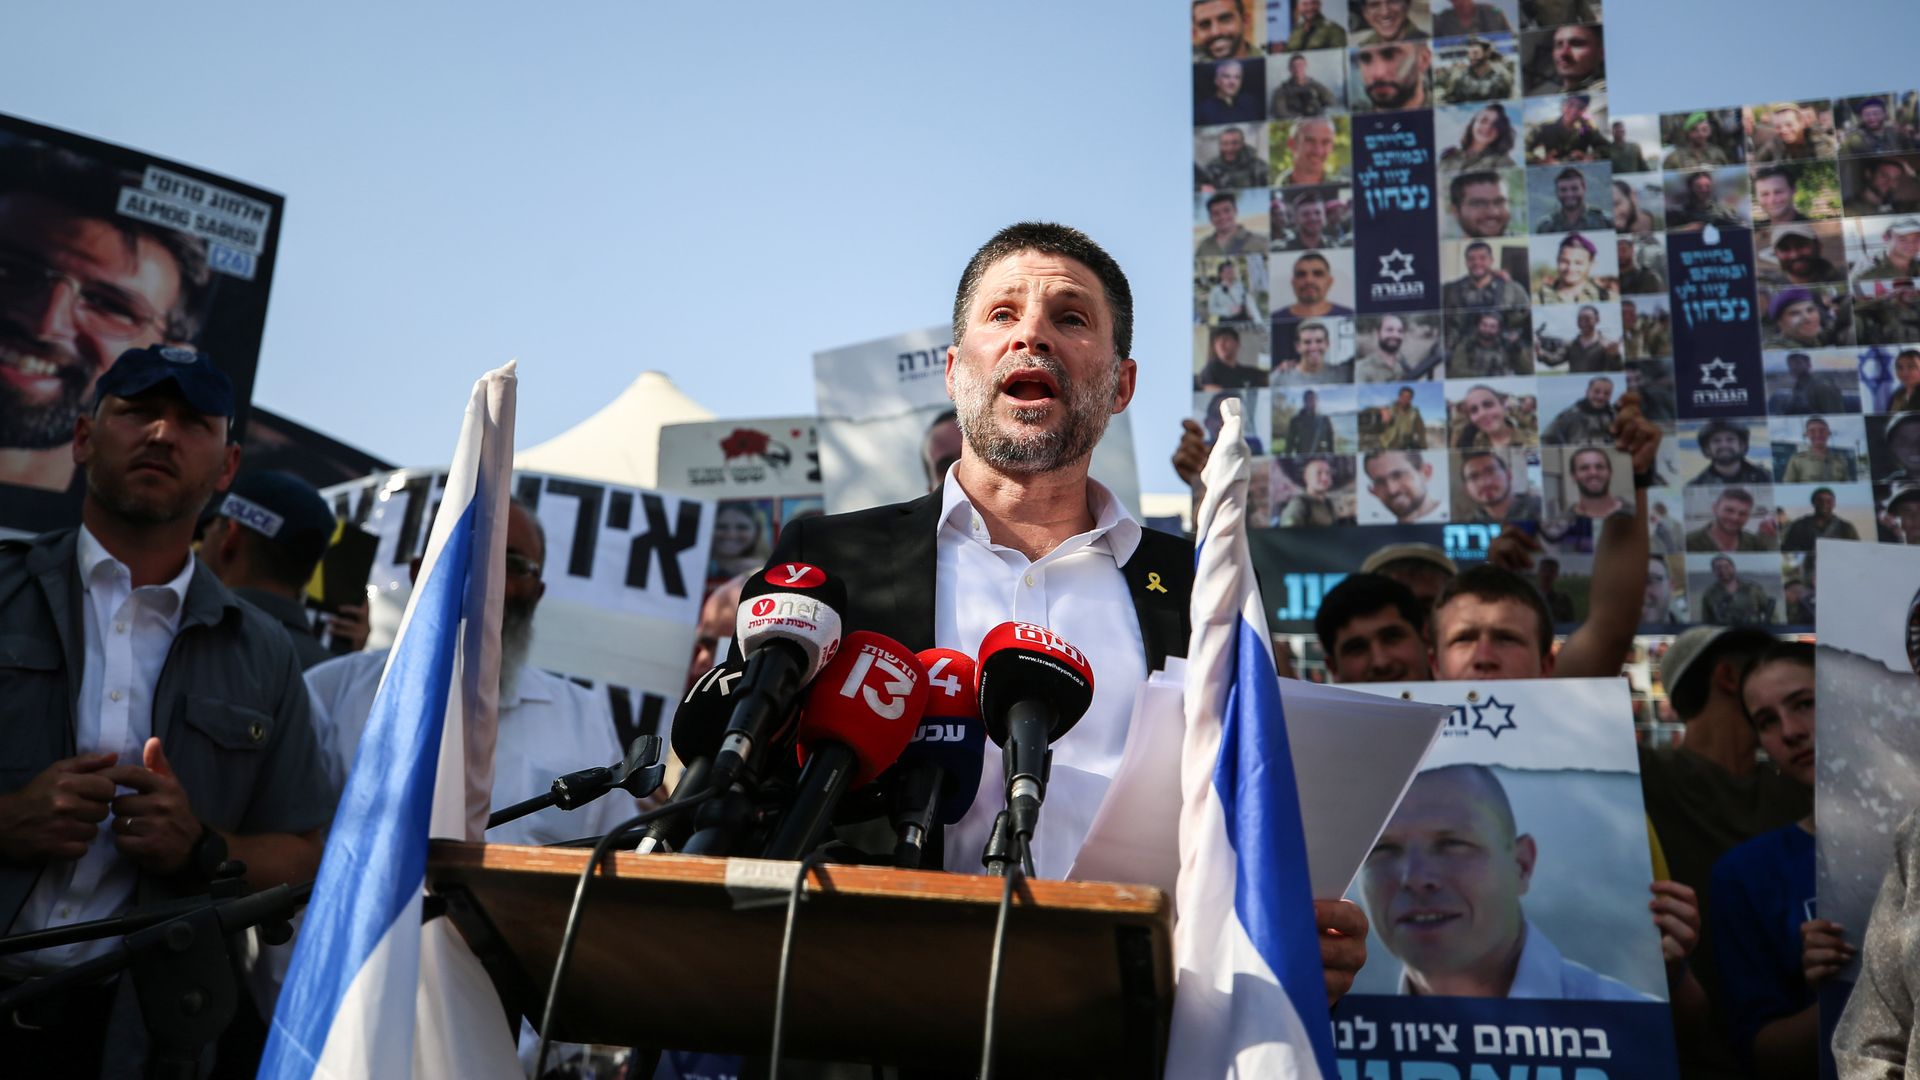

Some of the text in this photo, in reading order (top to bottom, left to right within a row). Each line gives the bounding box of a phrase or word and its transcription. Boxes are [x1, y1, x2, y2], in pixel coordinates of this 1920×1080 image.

[126, 194, 191, 228] ALMOG
[212, 243, 251, 275] (26)
[748, 616, 785, 629] אחרונות
[752, 598, 821, 622] ynet
[861, 643, 918, 682] חדשות
[928, 657, 962, 697] 4
[840, 652, 914, 720] 13
[911, 724, 966, 743] עכש
[1390, 1022, 1459, 1053] ציוו
[1472, 1024, 1612, 1059] במותם
